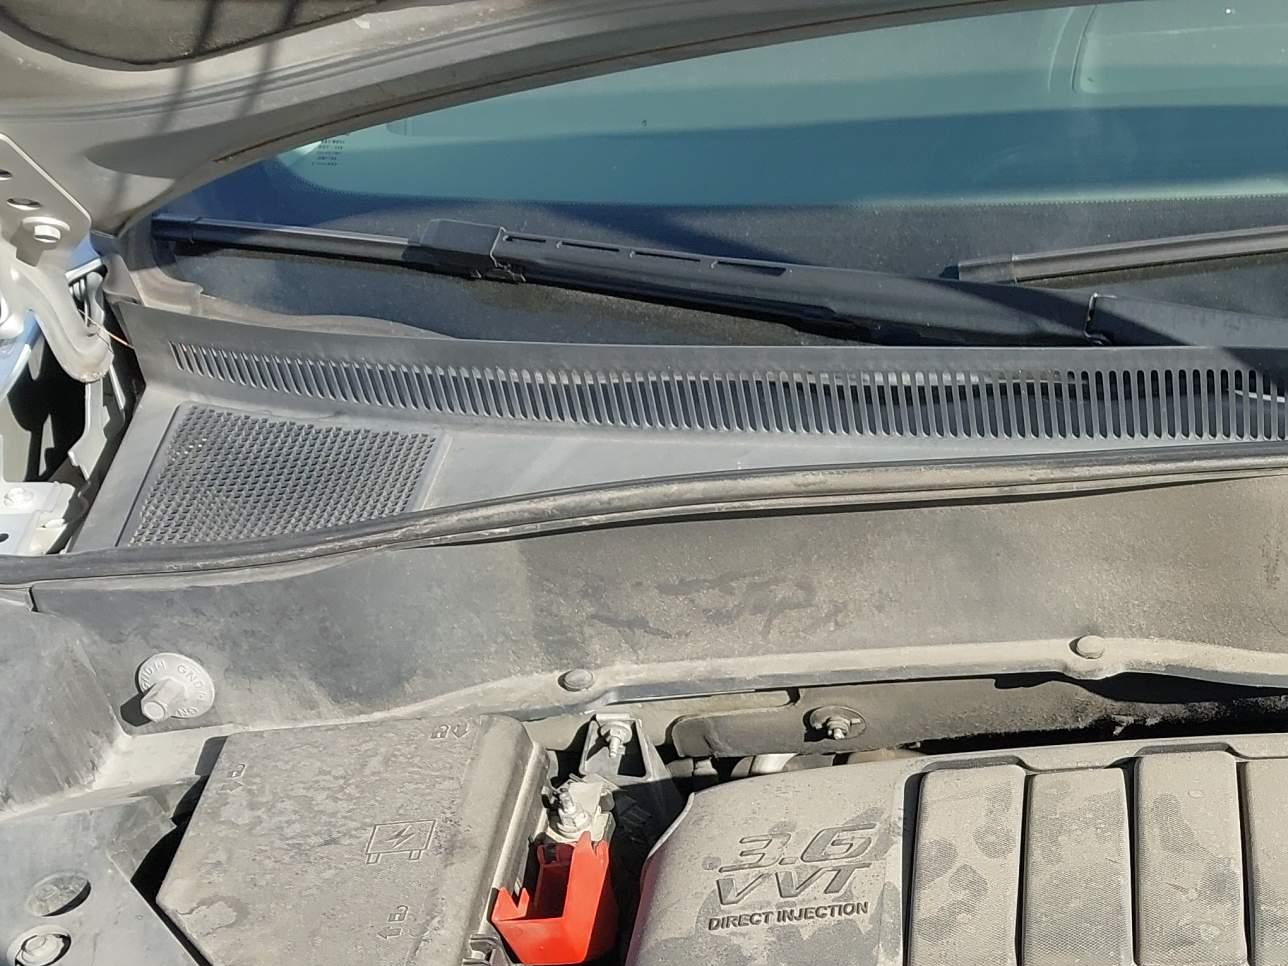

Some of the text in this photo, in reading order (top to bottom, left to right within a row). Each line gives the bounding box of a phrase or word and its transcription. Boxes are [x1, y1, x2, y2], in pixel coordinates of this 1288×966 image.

[718, 823, 877, 873] 3.6
[716, 862, 873, 906] VVT
[708, 901, 869, 931] DIRECT INJECTION
